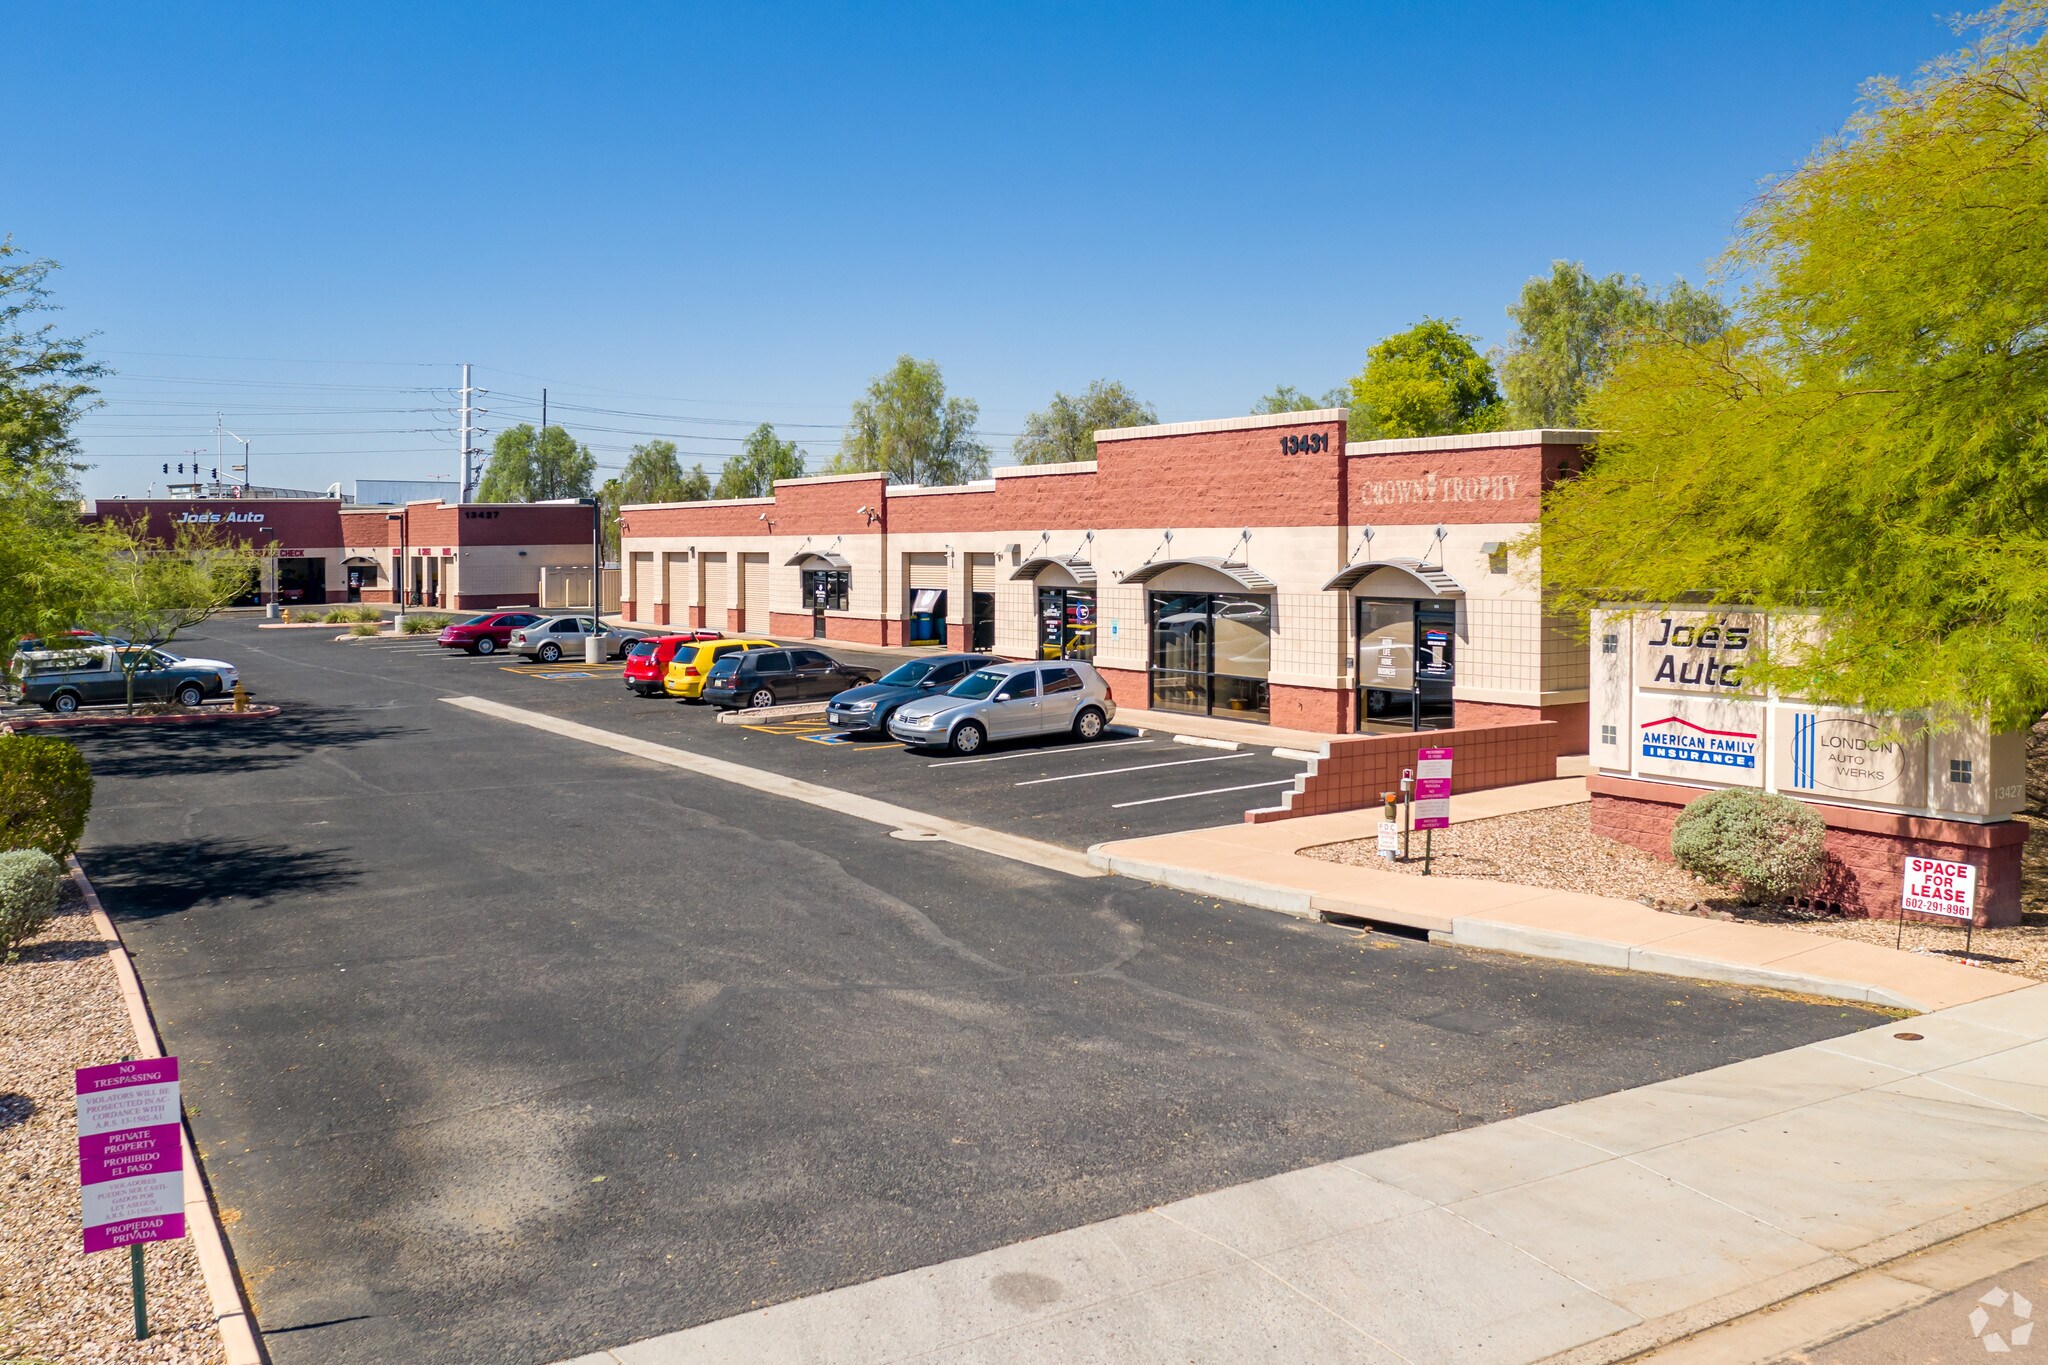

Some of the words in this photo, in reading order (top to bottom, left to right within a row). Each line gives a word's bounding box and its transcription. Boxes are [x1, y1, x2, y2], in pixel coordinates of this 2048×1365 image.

[1280, 432, 1328, 455] 13431
[1361, 479, 1426, 506] CROWN
[1439, 475, 1520, 503] TROPHY
[177, 511, 221, 523] Joe's
[225, 511, 265, 523] Auto
[464, 511, 500, 520] 13427
[280, 549, 305, 557] CHECK
[1648, 618, 1750, 650] Joe's
[1654, 654, 1744, 687] Auto
[1643, 732, 1705, 749] AMERICAN
[1710, 738, 1755, 754] FAMILY
[1820, 735, 1893, 753] LONDON
[1649, 747, 1746, 766] INSURANCE
[1828, 753, 1865, 766] AUTO
[1836, 766, 1885, 781] WERKS
[1993, 784, 2023, 800] 13427
[1912, 859, 1968, 879] SPACE
[1925, 874, 1953, 888] FOR
[1911, 884, 1966, 903] LEASE
[1905, 897, 1970, 917] 602-291-8961
[119, 1064, 136, 1074] NO
[93, 1072, 162, 1088] TRESPASSING
[86, 1092, 135, 1105] VIOLATORS
[136, 1088, 157, 1097] WILL
[159, 1087, 170, 1095] BE
[87, 1099, 143, 1114] PROSECUTED
[145, 1097, 154, 1105] IN
[92, 1107, 141, 1121] CORDANCE
[142, 1105, 165, 1113] WITH
[95, 1120, 117, 1129] A.R.S.
[109, 1130, 151, 1144] PRIVATE
[104, 1139, 157, 1154] PROPERTY
[103, 1152, 160, 1168] PROHIBIDO
[112, 1167, 125, 1176] EL
[127, 1163, 153, 1173] PASO
[109, 1178, 157, 1190] VIOLADORES
[97, 1189, 127, 1200] PUEDEN
[128, 1186, 143, 1195] SER
[112, 1195, 138, 1204] GADOS
[140, 1193, 154, 1201] POR
[110, 1203, 126, 1212] LEY
[105, 1219, 164, 1236] PROPIEDAD
[113, 1229, 157, 1244] PRIVADA
